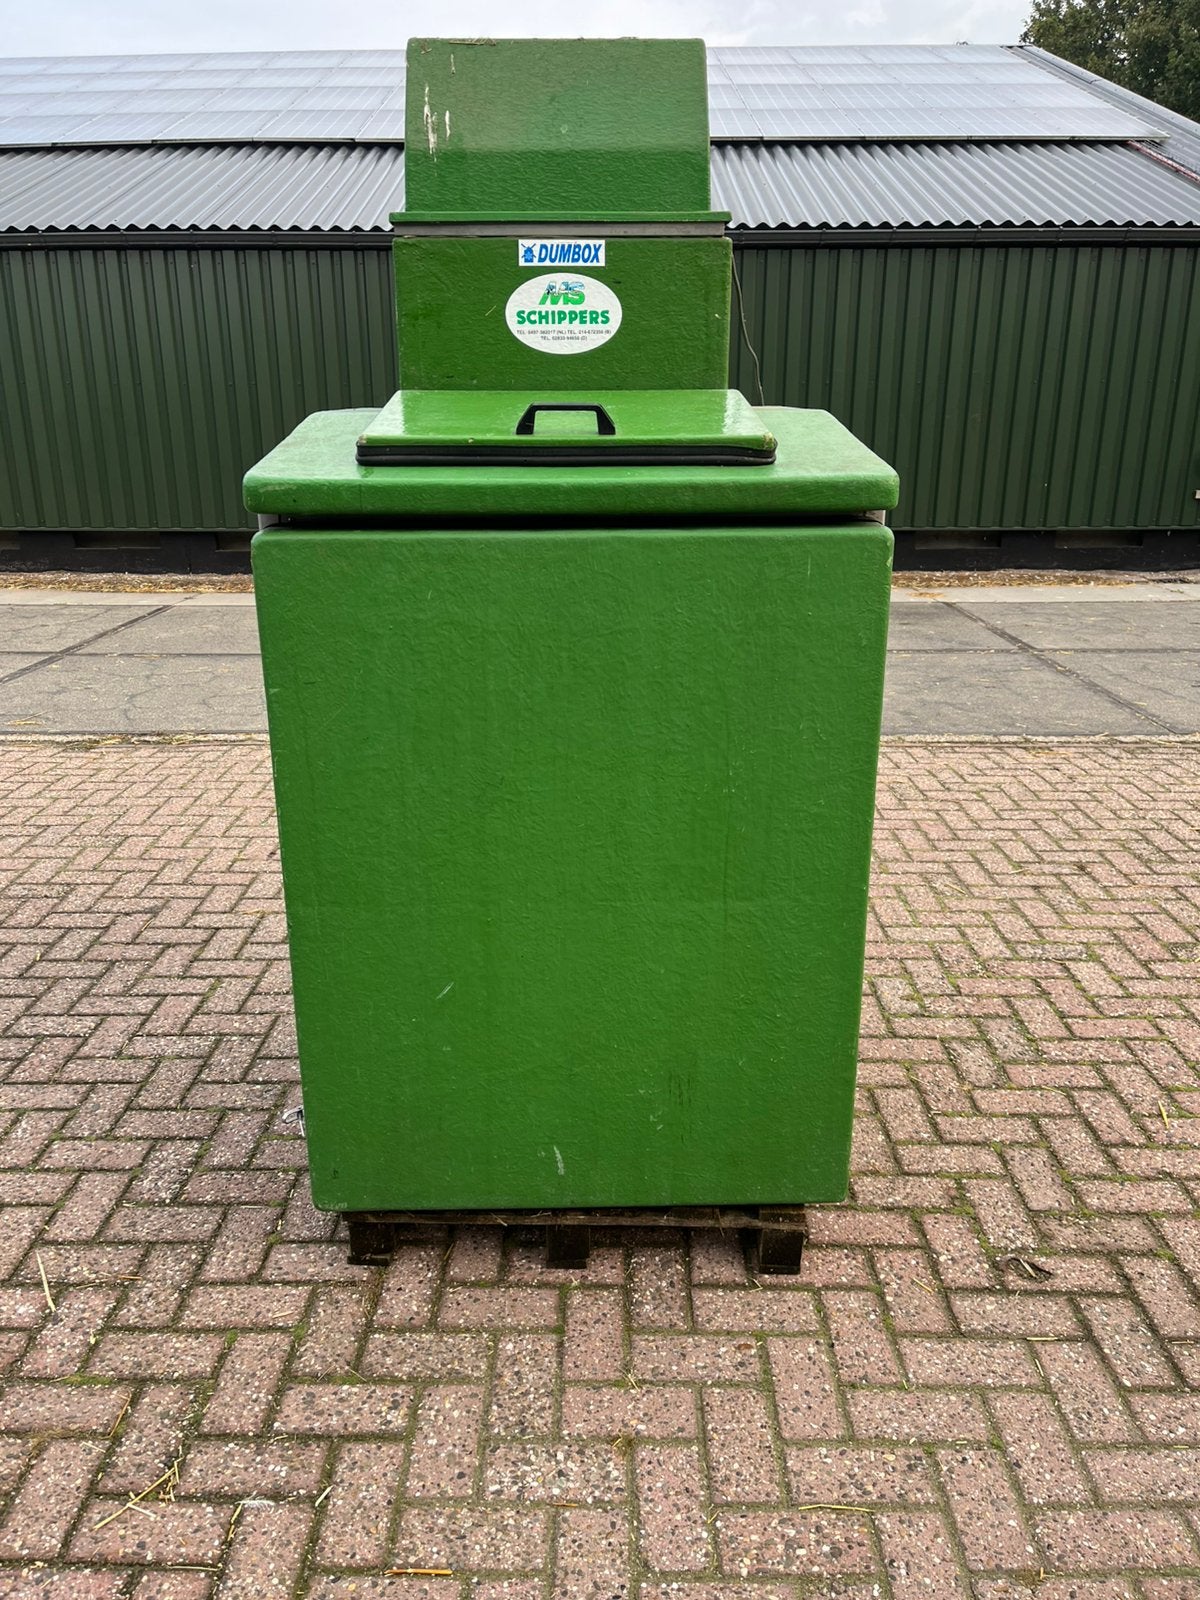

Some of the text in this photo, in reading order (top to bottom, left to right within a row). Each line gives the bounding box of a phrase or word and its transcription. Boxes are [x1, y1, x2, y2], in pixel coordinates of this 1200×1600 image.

[538, 243, 602, 263] DUMBOX
[539, 281, 586, 305] MS
[516, 310, 610, 325] SCHIPPERS
